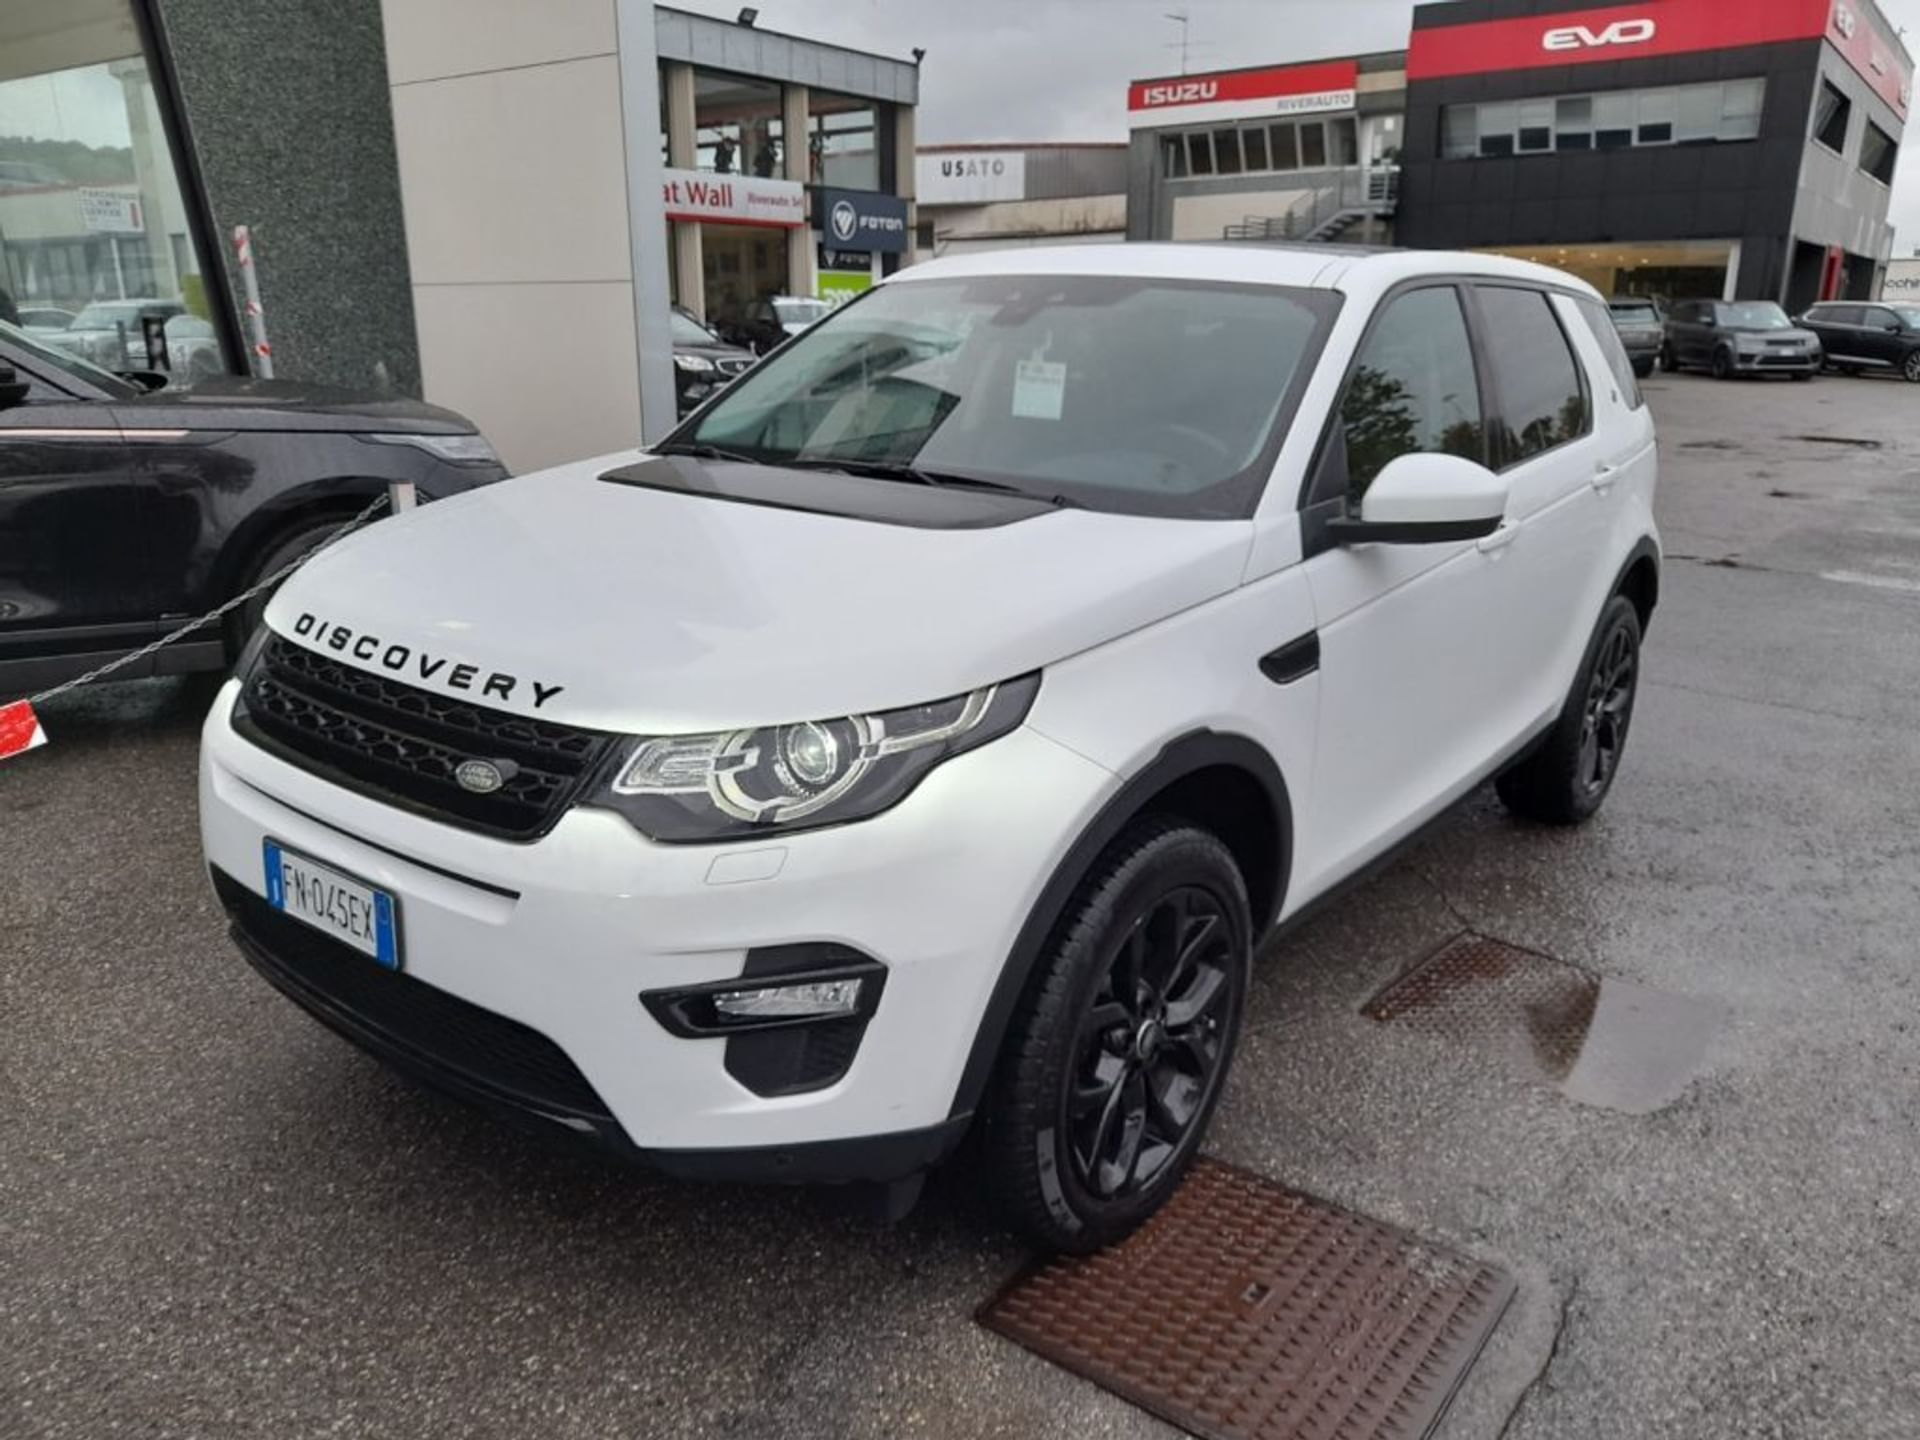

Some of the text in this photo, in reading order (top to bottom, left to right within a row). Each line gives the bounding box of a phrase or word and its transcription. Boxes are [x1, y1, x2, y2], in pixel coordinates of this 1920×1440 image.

[1542, 19, 1656, 50] EVO
[1143, 80, 1218, 106] ISUZU
[1276, 93, 1351, 111] RIVERAUTO
[941, 158, 1005, 178] USATO
[685, 180, 734, 208] Wall
[859, 215, 904, 231] FOTON
[294, 612, 565, 708] DISCOVERY
